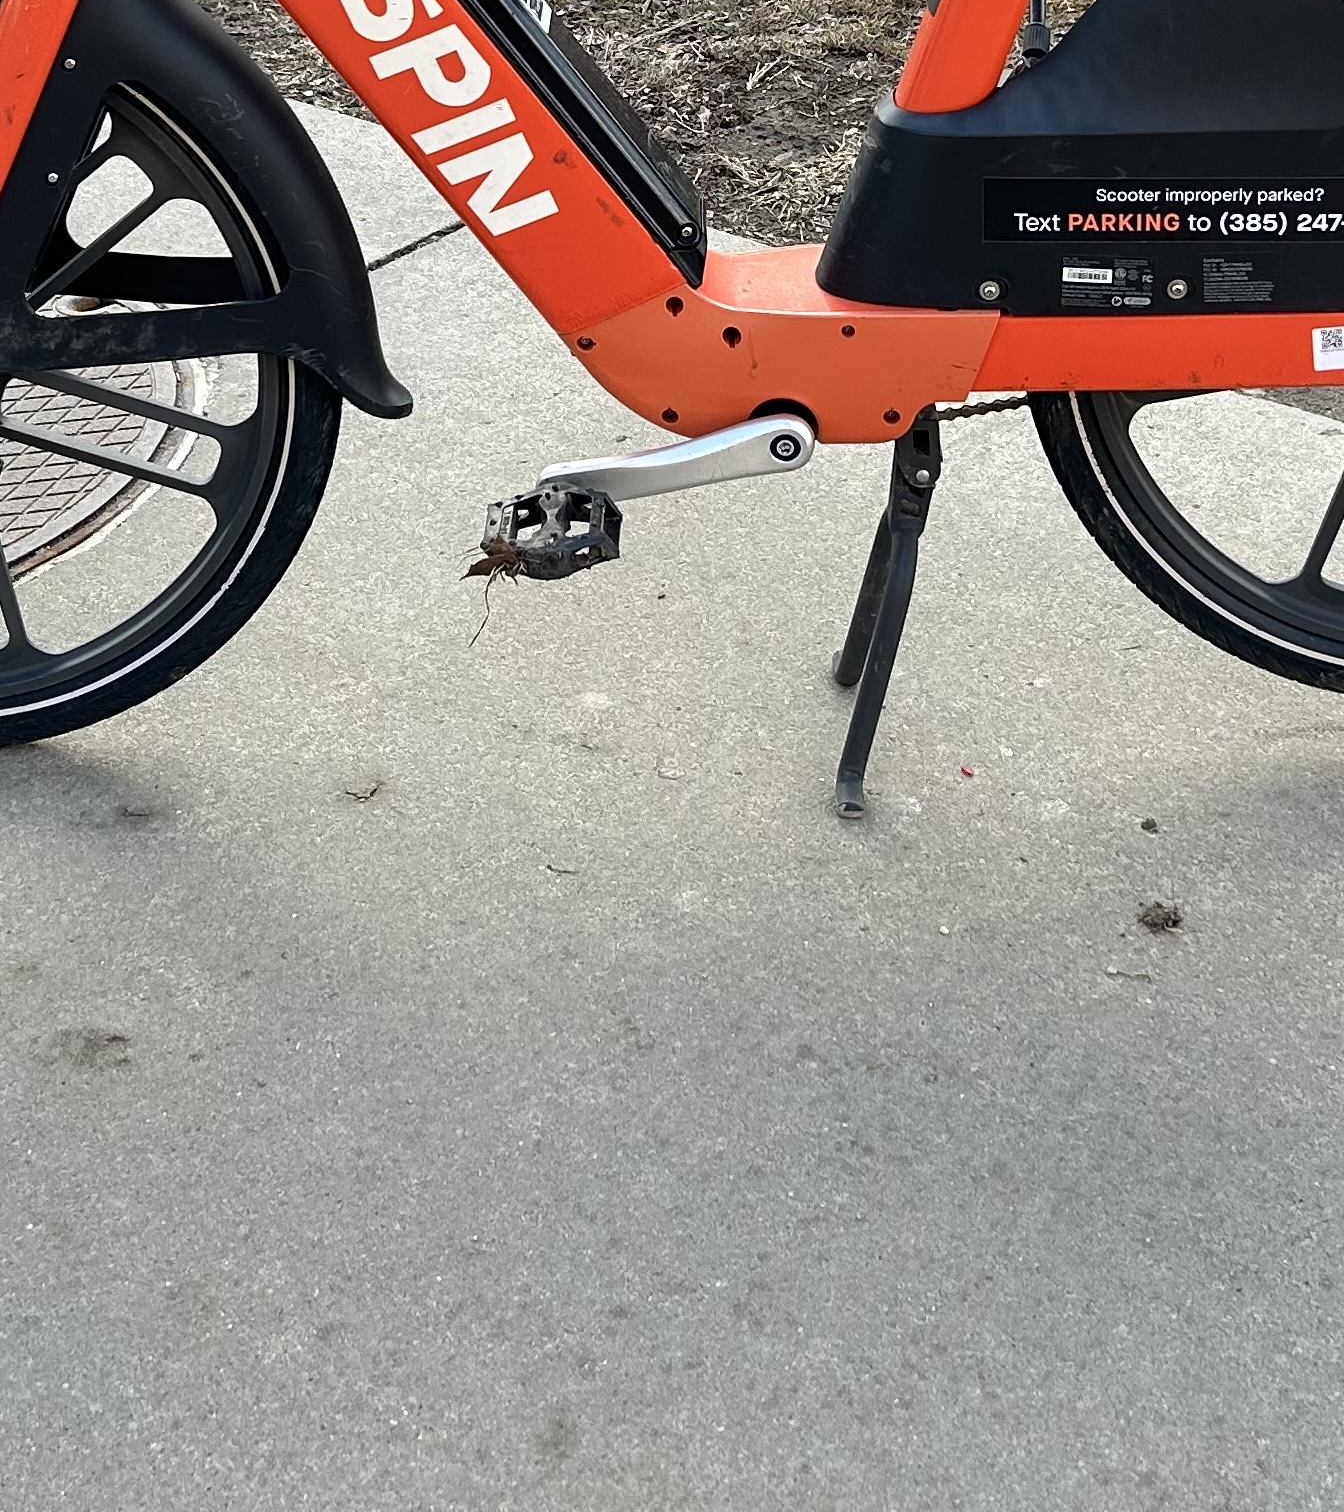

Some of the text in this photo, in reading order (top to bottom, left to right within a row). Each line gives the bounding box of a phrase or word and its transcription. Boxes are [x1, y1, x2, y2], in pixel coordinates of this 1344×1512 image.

[1095, 187, 1325, 206] Scooter improperly parked?
[1013, 212, 1061, 232] Text
[1068, 212, 1180, 232] PARKING
[1187, 213, 1212, 232] to
[1219, 211, 1288, 236] (385)
